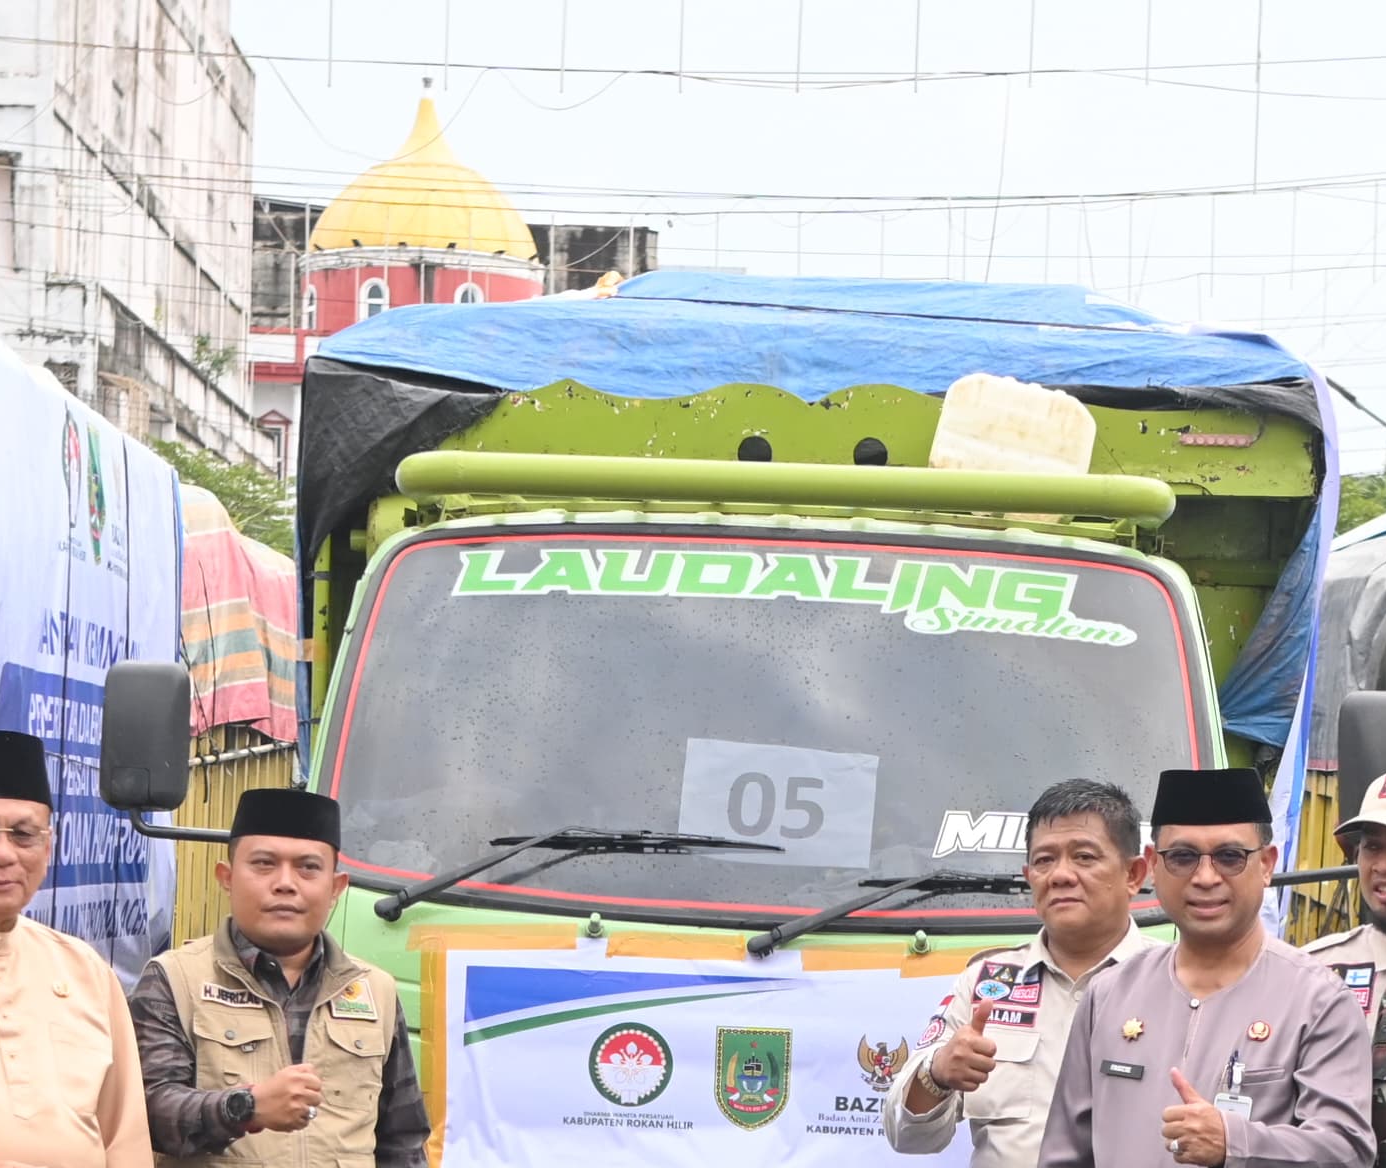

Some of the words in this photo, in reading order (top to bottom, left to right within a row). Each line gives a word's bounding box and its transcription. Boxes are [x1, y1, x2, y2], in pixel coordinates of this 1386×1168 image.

[451, 548, 1078, 622] LAUDALING
[904, 606, 1137, 646] Simalem
[728, 772, 825, 839] 05
[203, 984, 214, 997] H.
[563, 1116, 624, 1127] KABUPATEN
[626, 1118, 664, 1129] ROKAN
[667, 1120, 694, 1130] HILIR
[818, 1113, 846, 1122] Badan
[806, 1125, 874, 1136] KABUPATEN
